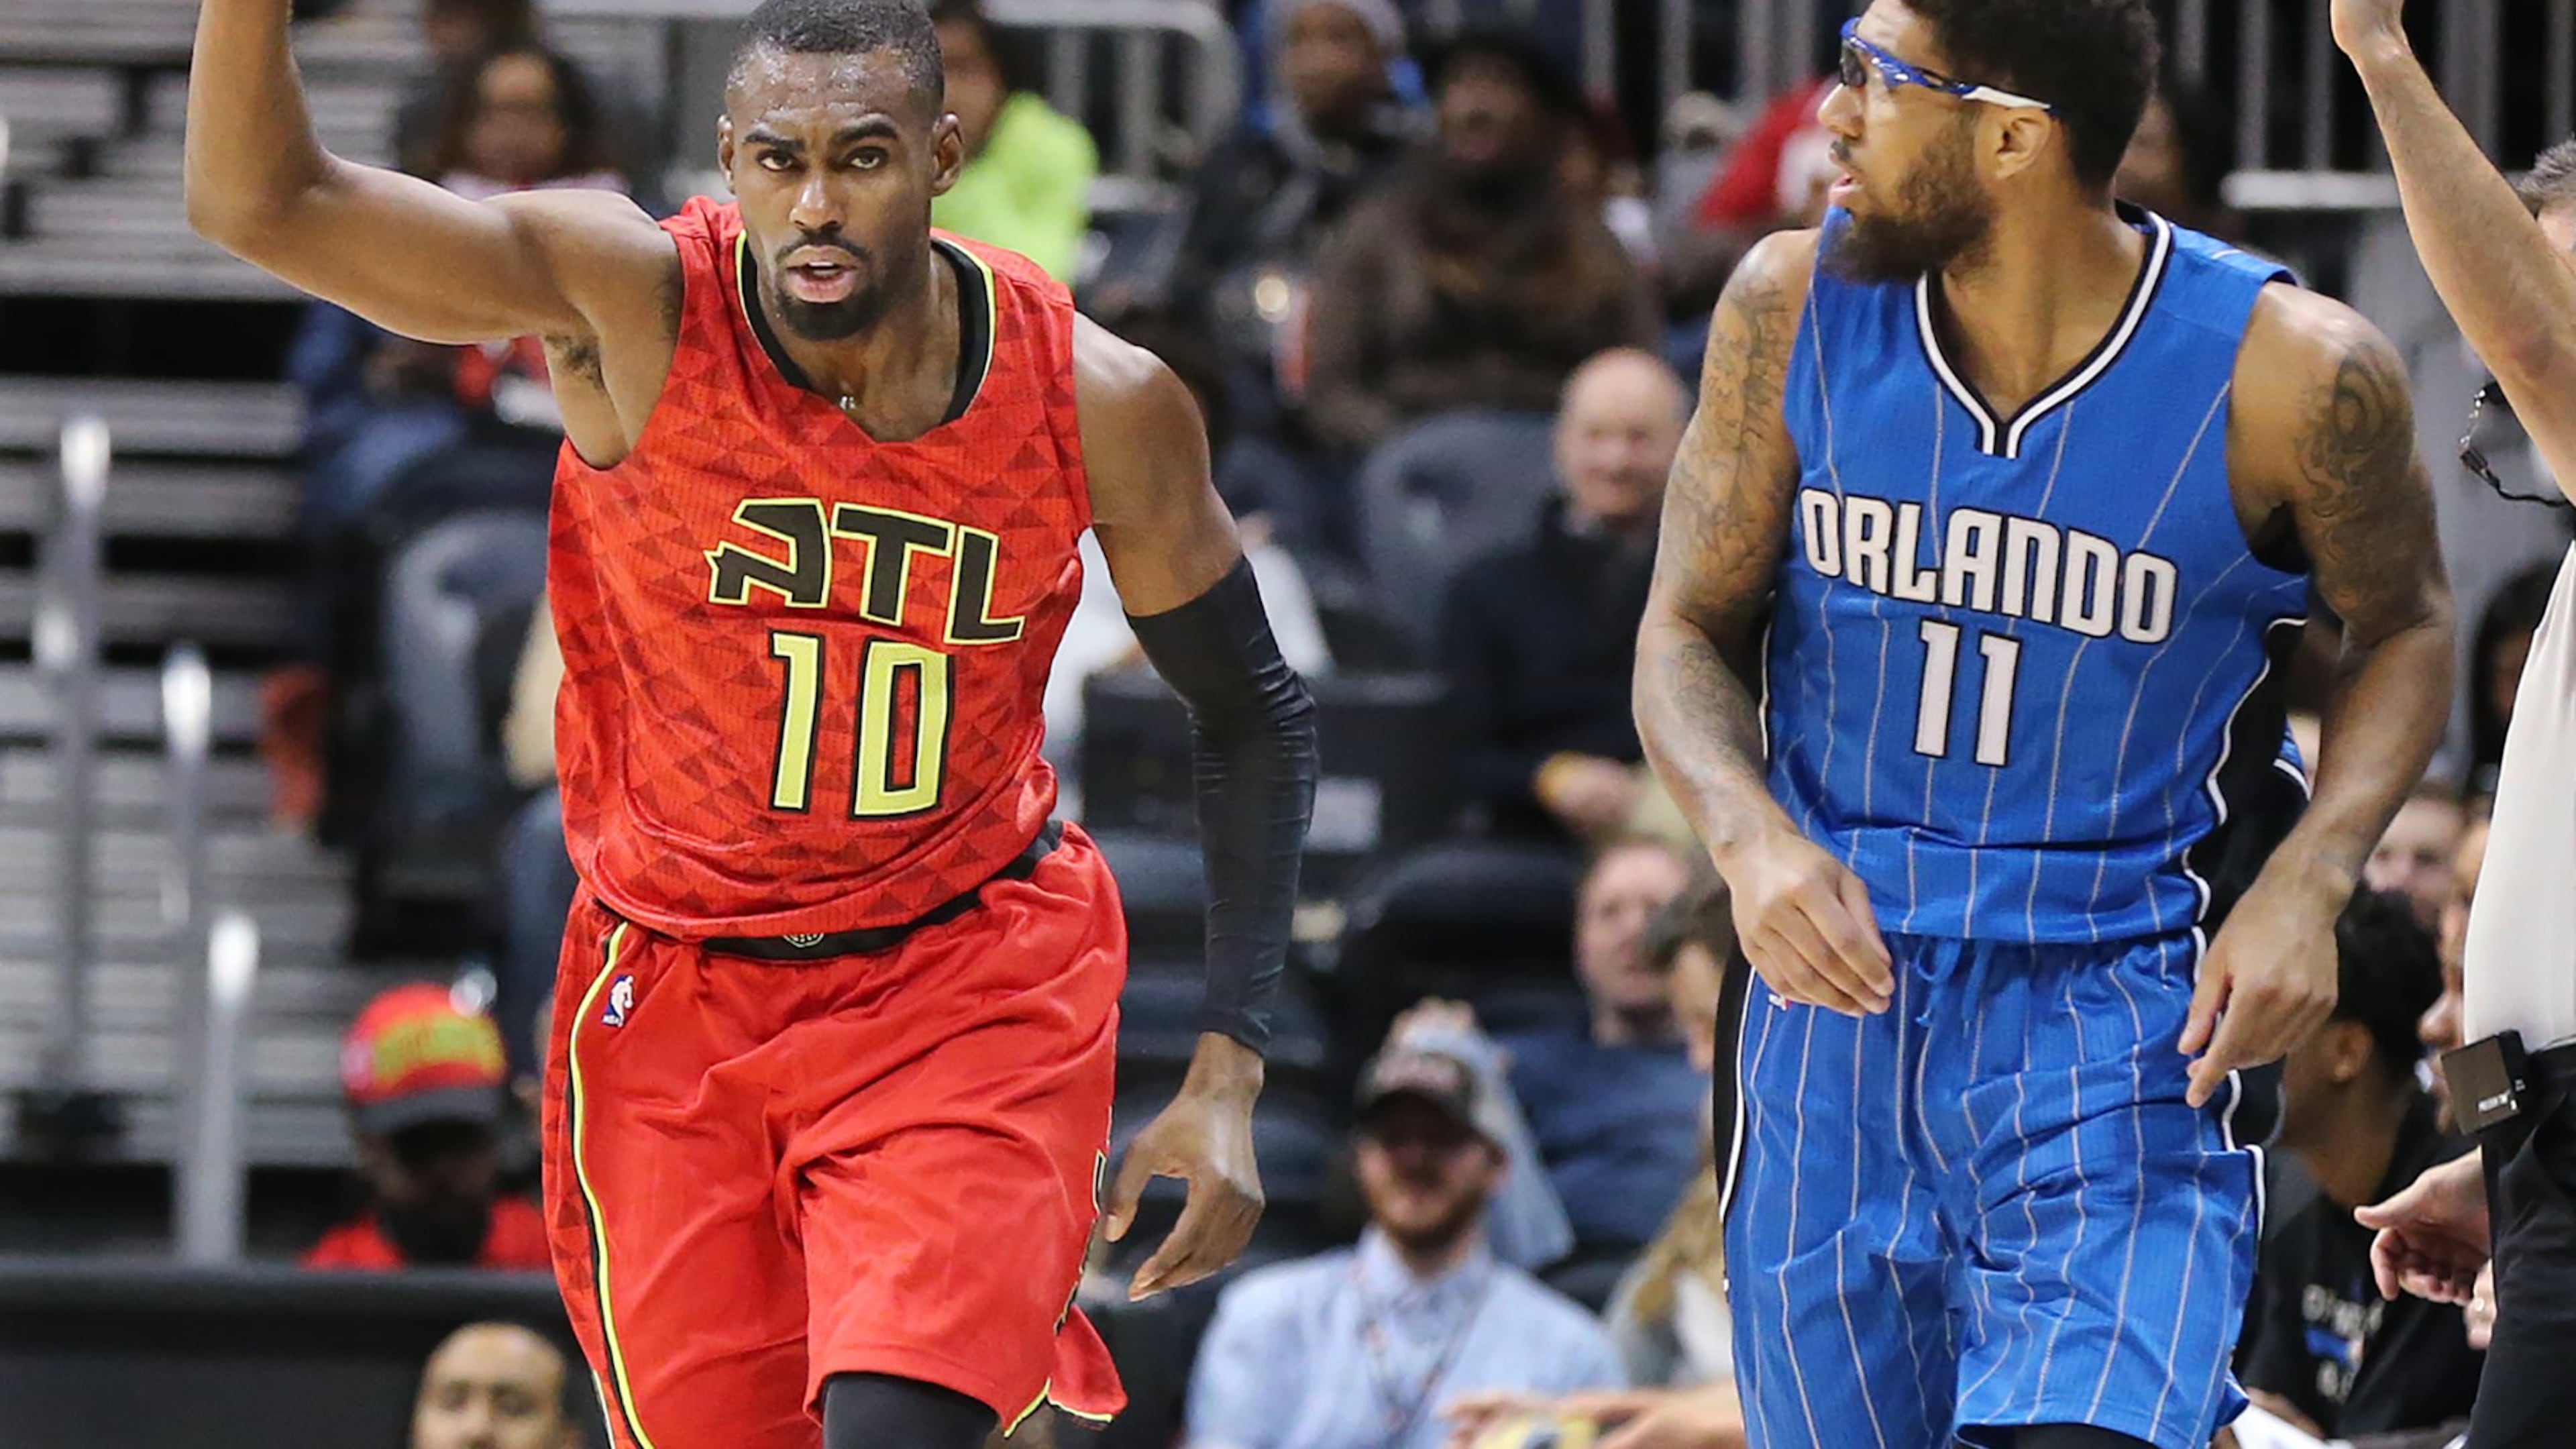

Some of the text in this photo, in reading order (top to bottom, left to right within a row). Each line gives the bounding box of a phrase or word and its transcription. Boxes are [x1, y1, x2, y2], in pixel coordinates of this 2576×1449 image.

[703, 497, 1026, 644] ATL
[1798, 486, 2180, 645] ORLANDO
[768, 629, 955, 821] 10
[1913, 616, 2021, 767] 11
